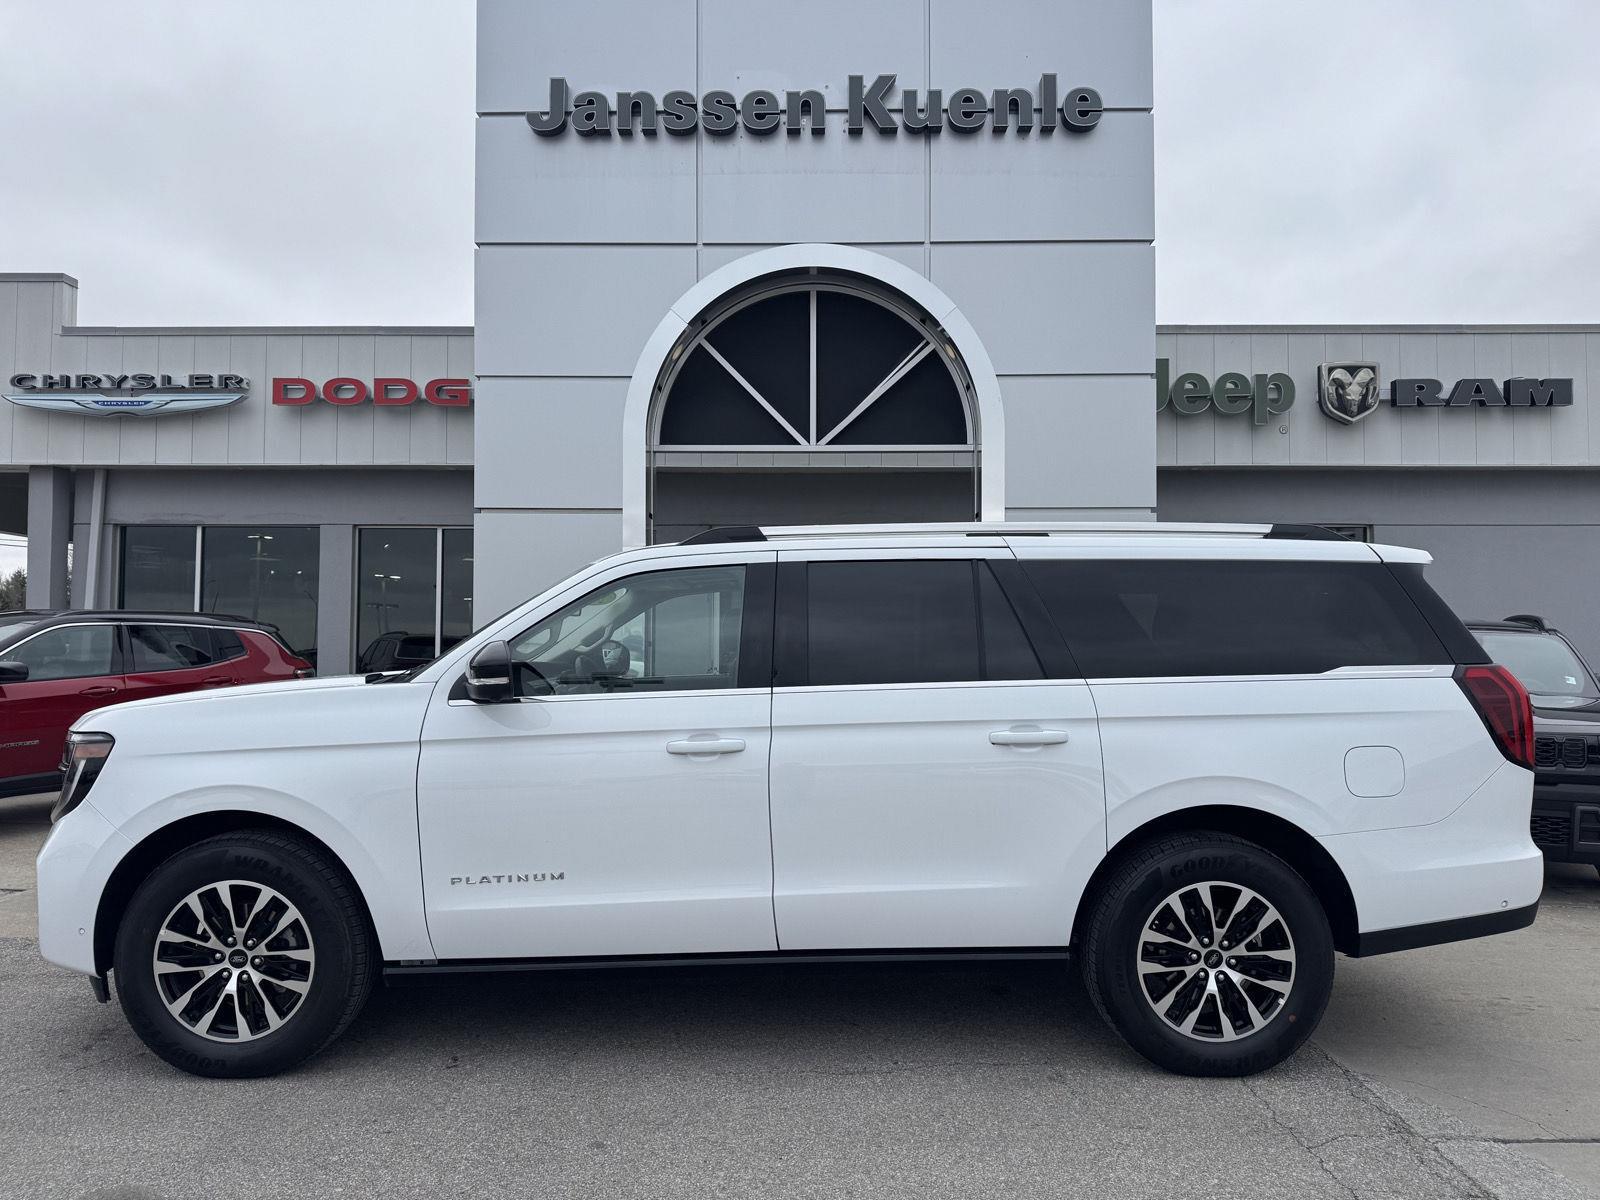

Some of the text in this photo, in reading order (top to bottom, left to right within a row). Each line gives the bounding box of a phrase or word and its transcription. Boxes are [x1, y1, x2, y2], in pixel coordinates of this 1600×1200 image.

[525, 72, 1104, 136] Janssen Kuenle
[10, 373, 246, 390] CHRYSLER
[272, 377, 470, 407] DODG
[1390, 377, 1574, 407] RAM
[450, 871, 565, 886] PLATINUM
